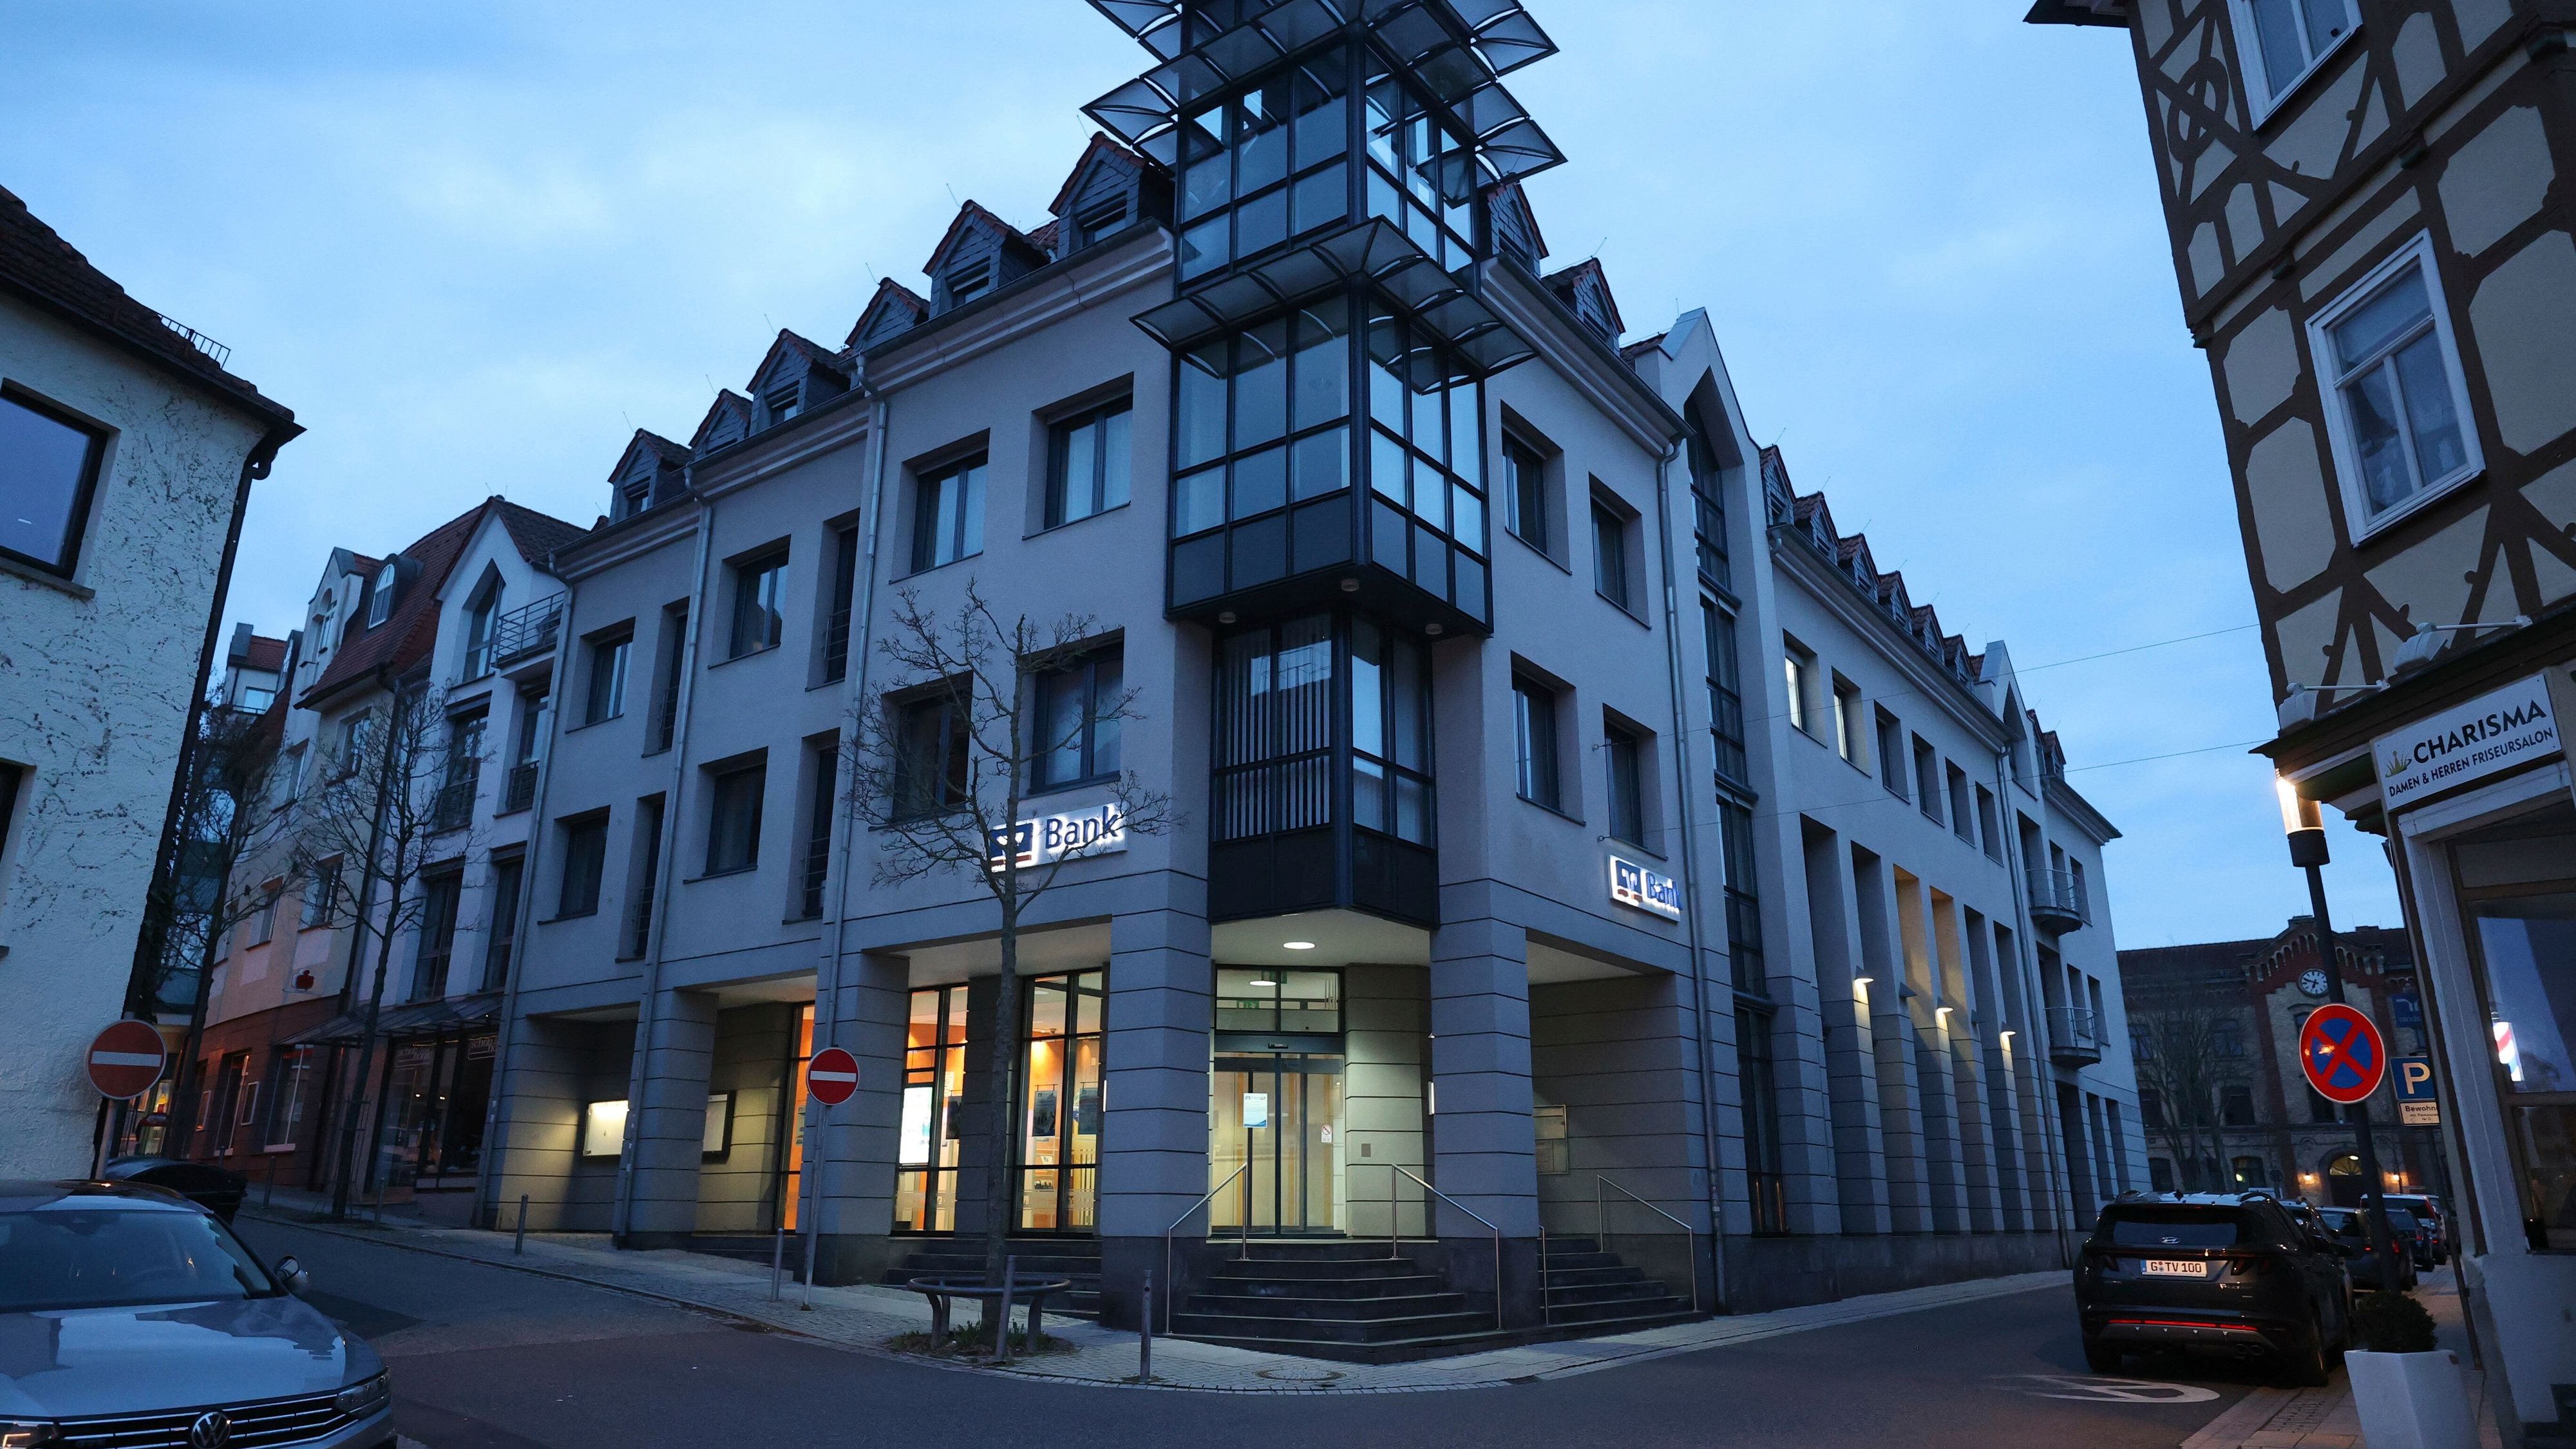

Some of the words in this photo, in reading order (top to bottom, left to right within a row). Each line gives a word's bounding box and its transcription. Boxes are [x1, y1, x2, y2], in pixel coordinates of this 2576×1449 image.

[2413, 699, 2547, 764] CHARISMA
[2389, 775, 2420, 797] DAMEN
[2422, 773, 2430, 784] &
[2432, 757, 2470, 780] HERREN
[2472, 727, 2554, 766] FRISEURSALON
[1045, 806, 1119, 849] Bank
[1645, 872, 1683, 911] Bank
[2402, 1062, 2430, 1094] P
[2151, 1262, 2157, 1271] G
[2164, 1262, 2178, 1272] TV
[2181, 1263, 2201, 1273] 100
